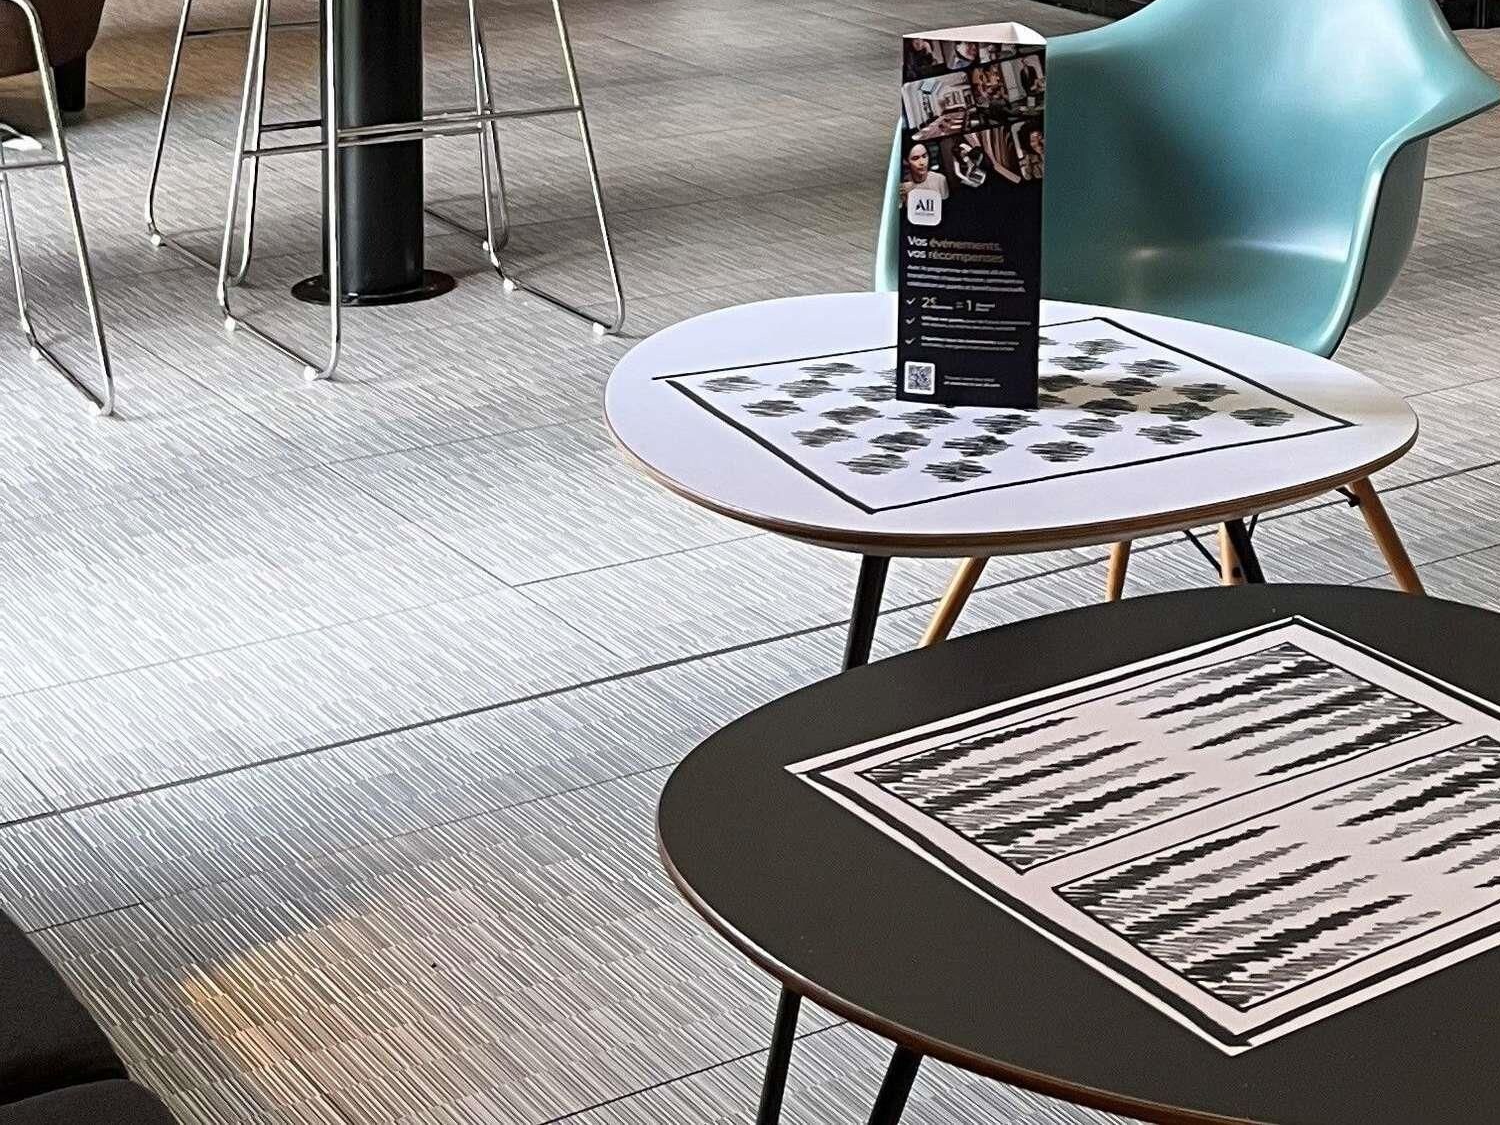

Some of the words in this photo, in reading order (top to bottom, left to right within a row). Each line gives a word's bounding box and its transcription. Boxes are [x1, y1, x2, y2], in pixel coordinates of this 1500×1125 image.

[907, 235, 928, 247] Vos
[907, 249, 927, 259] vos
[928, 250, 1005, 264] récompenses
